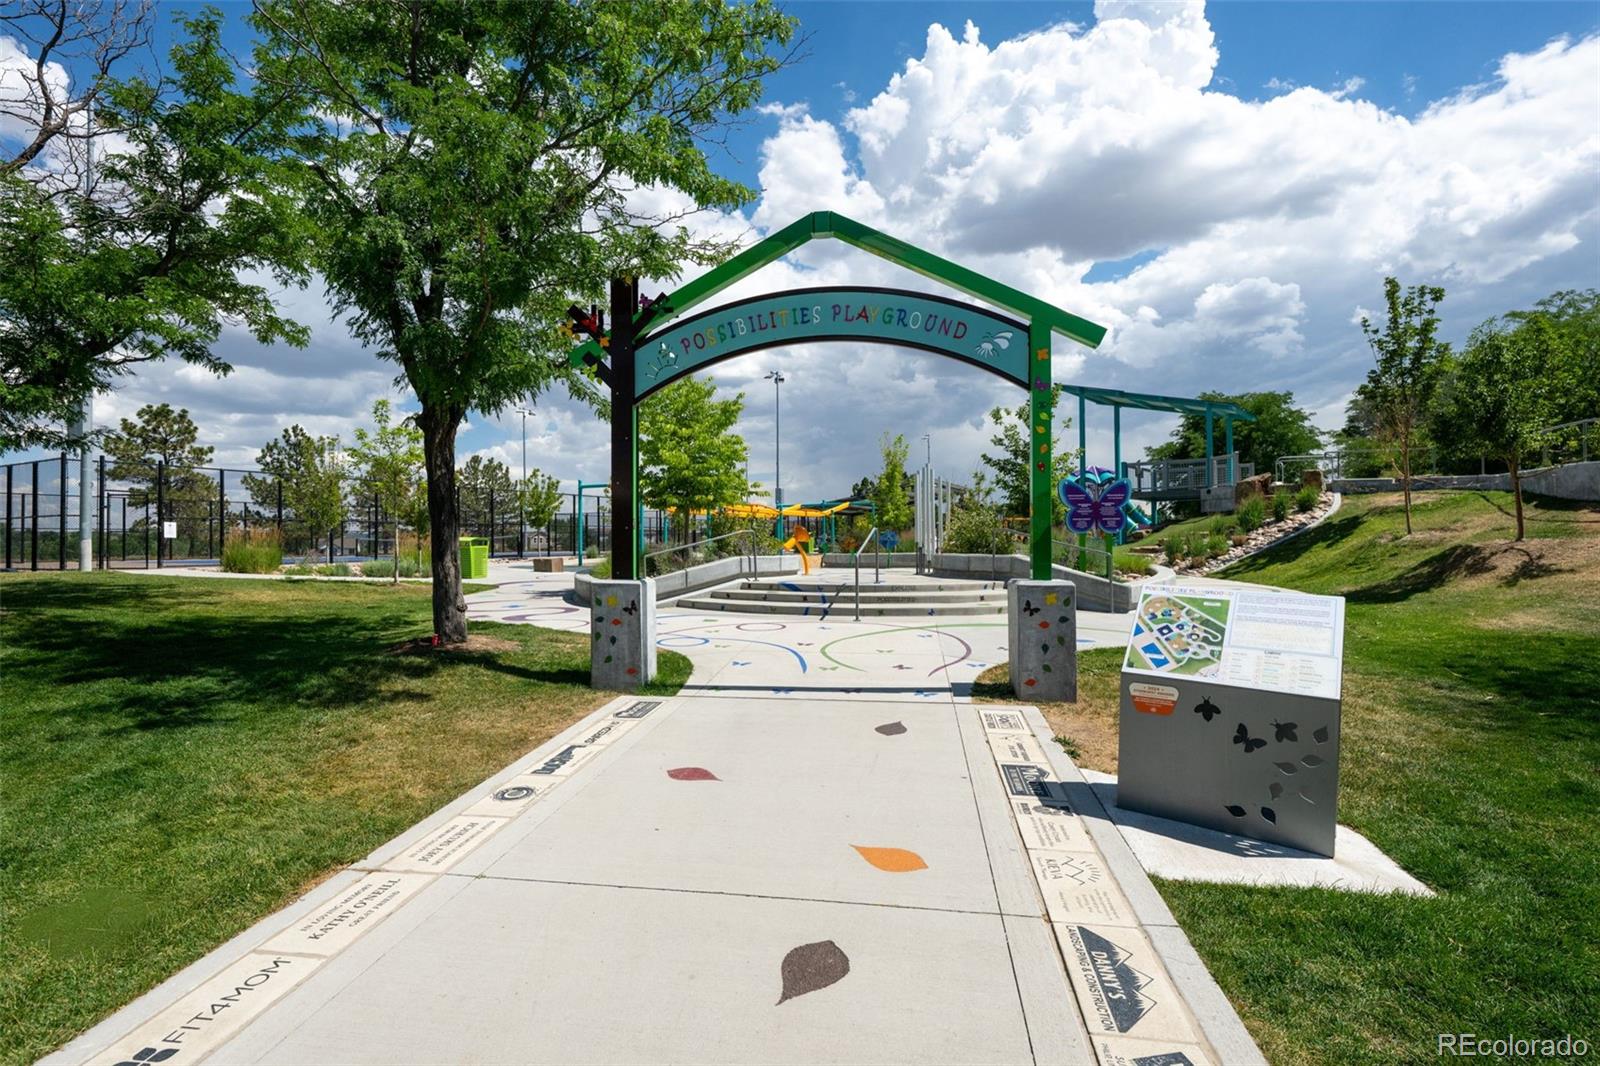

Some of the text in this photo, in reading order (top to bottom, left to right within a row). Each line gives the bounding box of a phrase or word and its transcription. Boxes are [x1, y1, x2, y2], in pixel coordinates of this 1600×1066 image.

[680, 303, 968, 354] POSSIBILITIES PLAYGROUND
[308, 878, 401, 941] KATHY O'NEILL
[162, 958, 292, 1044] FIT4MOM
[1065, 925, 1090, 967] LANDSCAPING
[1084, 973, 1116, 1032] CONSTRUCTION
[1090, 951, 1127, 1000] DANNY'S
